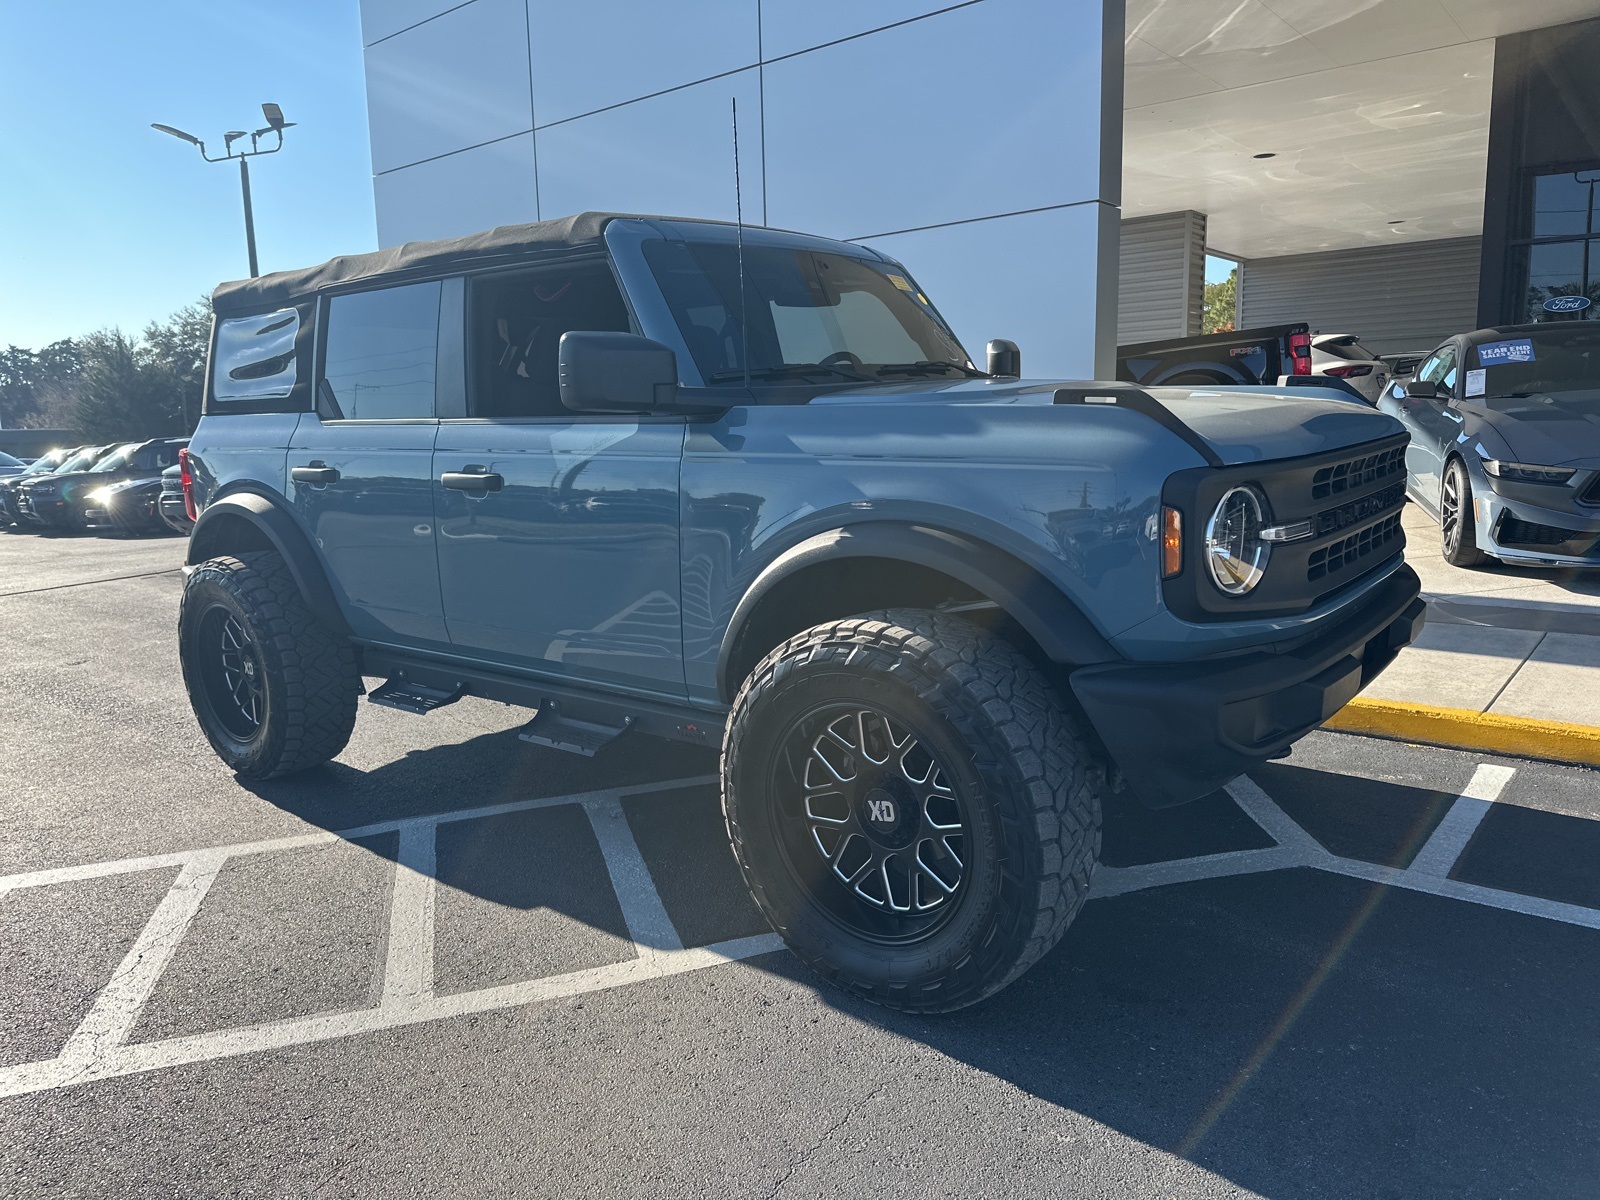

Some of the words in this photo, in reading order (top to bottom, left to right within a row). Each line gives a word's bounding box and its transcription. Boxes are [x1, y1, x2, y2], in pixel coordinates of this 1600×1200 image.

[1552, 298, 1581, 310] Ford
[1480, 346, 1508, 355] YEAR
[1509, 344, 1531, 352] END
[1482, 352, 1506, 360] SALES
[867, 800, 895, 822] XD
